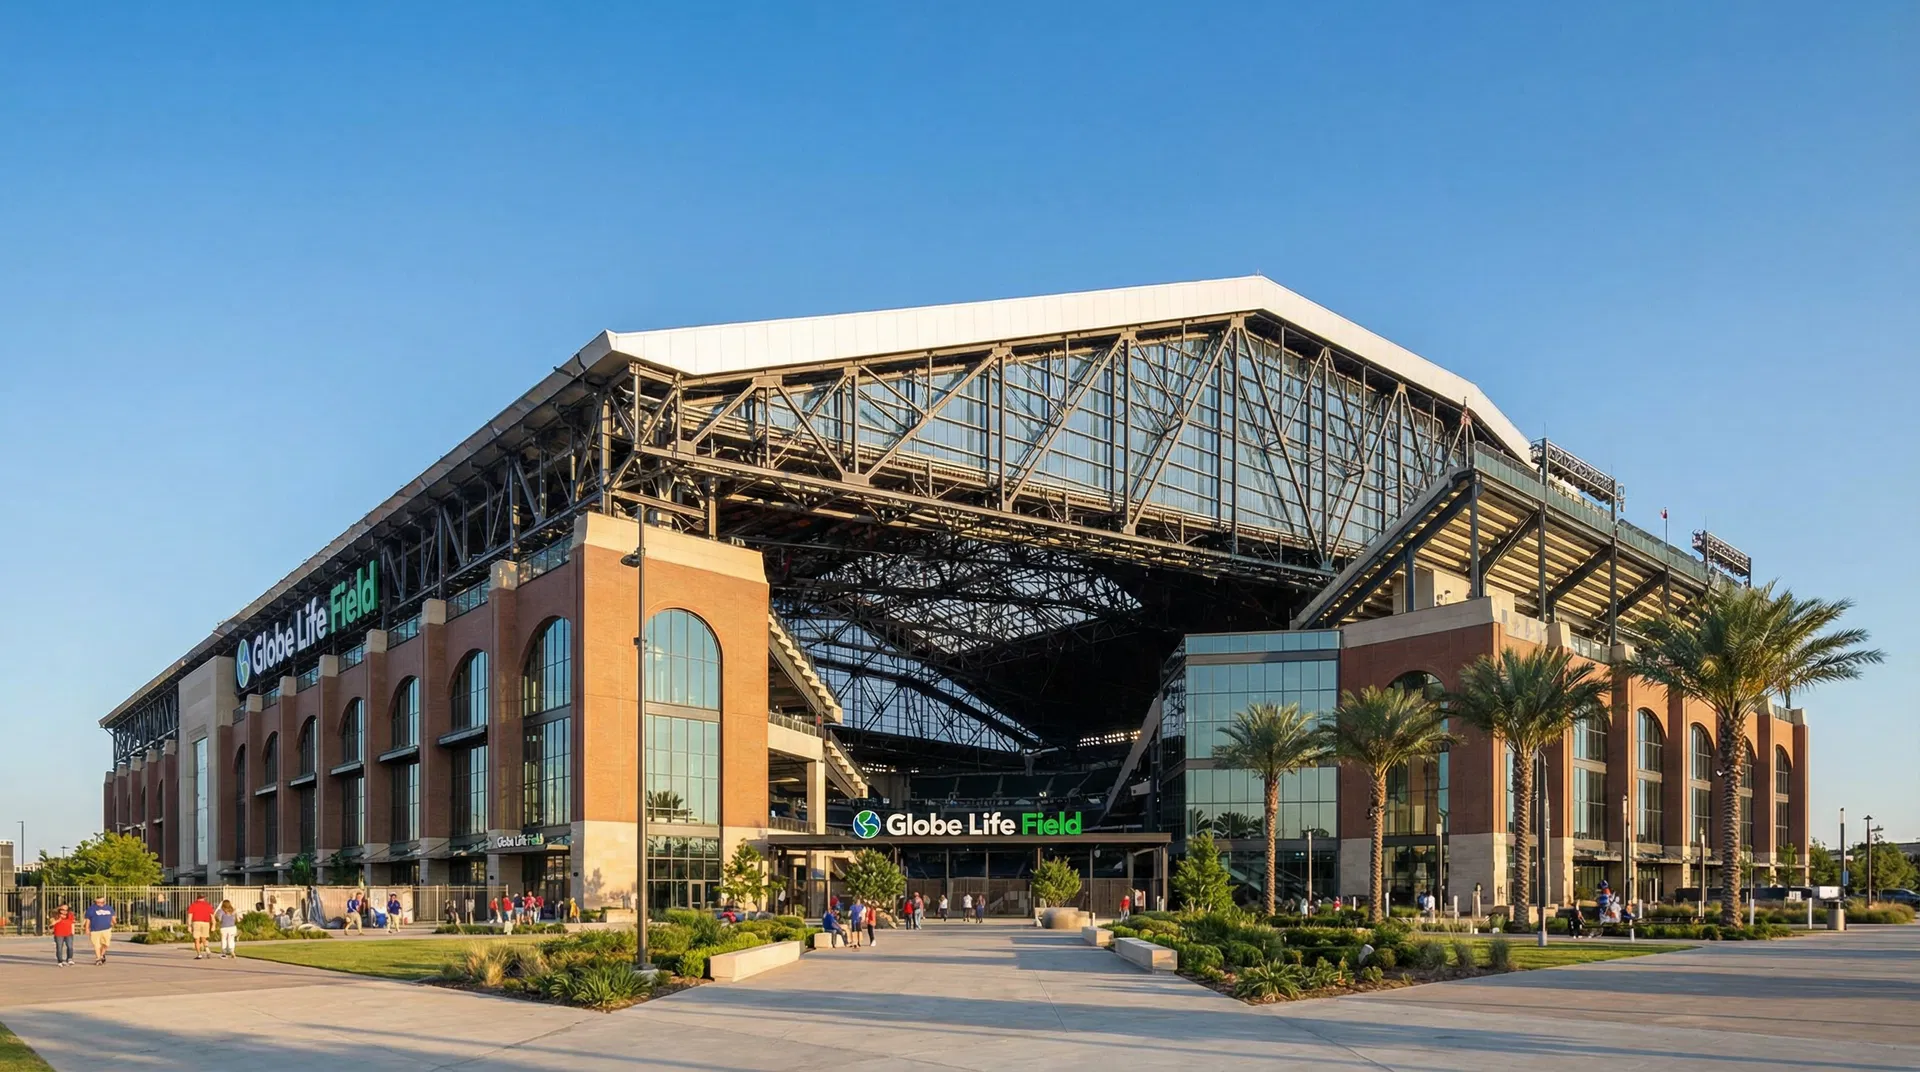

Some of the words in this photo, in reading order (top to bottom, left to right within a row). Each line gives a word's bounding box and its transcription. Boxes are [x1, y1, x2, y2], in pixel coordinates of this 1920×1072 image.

[253, 622, 295, 674] Globe
[297, 596, 327, 652] Life
[330, 560, 378, 634] Field
[886, 812, 962, 836] Globe
[969, 811, 1016, 836] Life
[1022, 811, 1082, 836] Field
